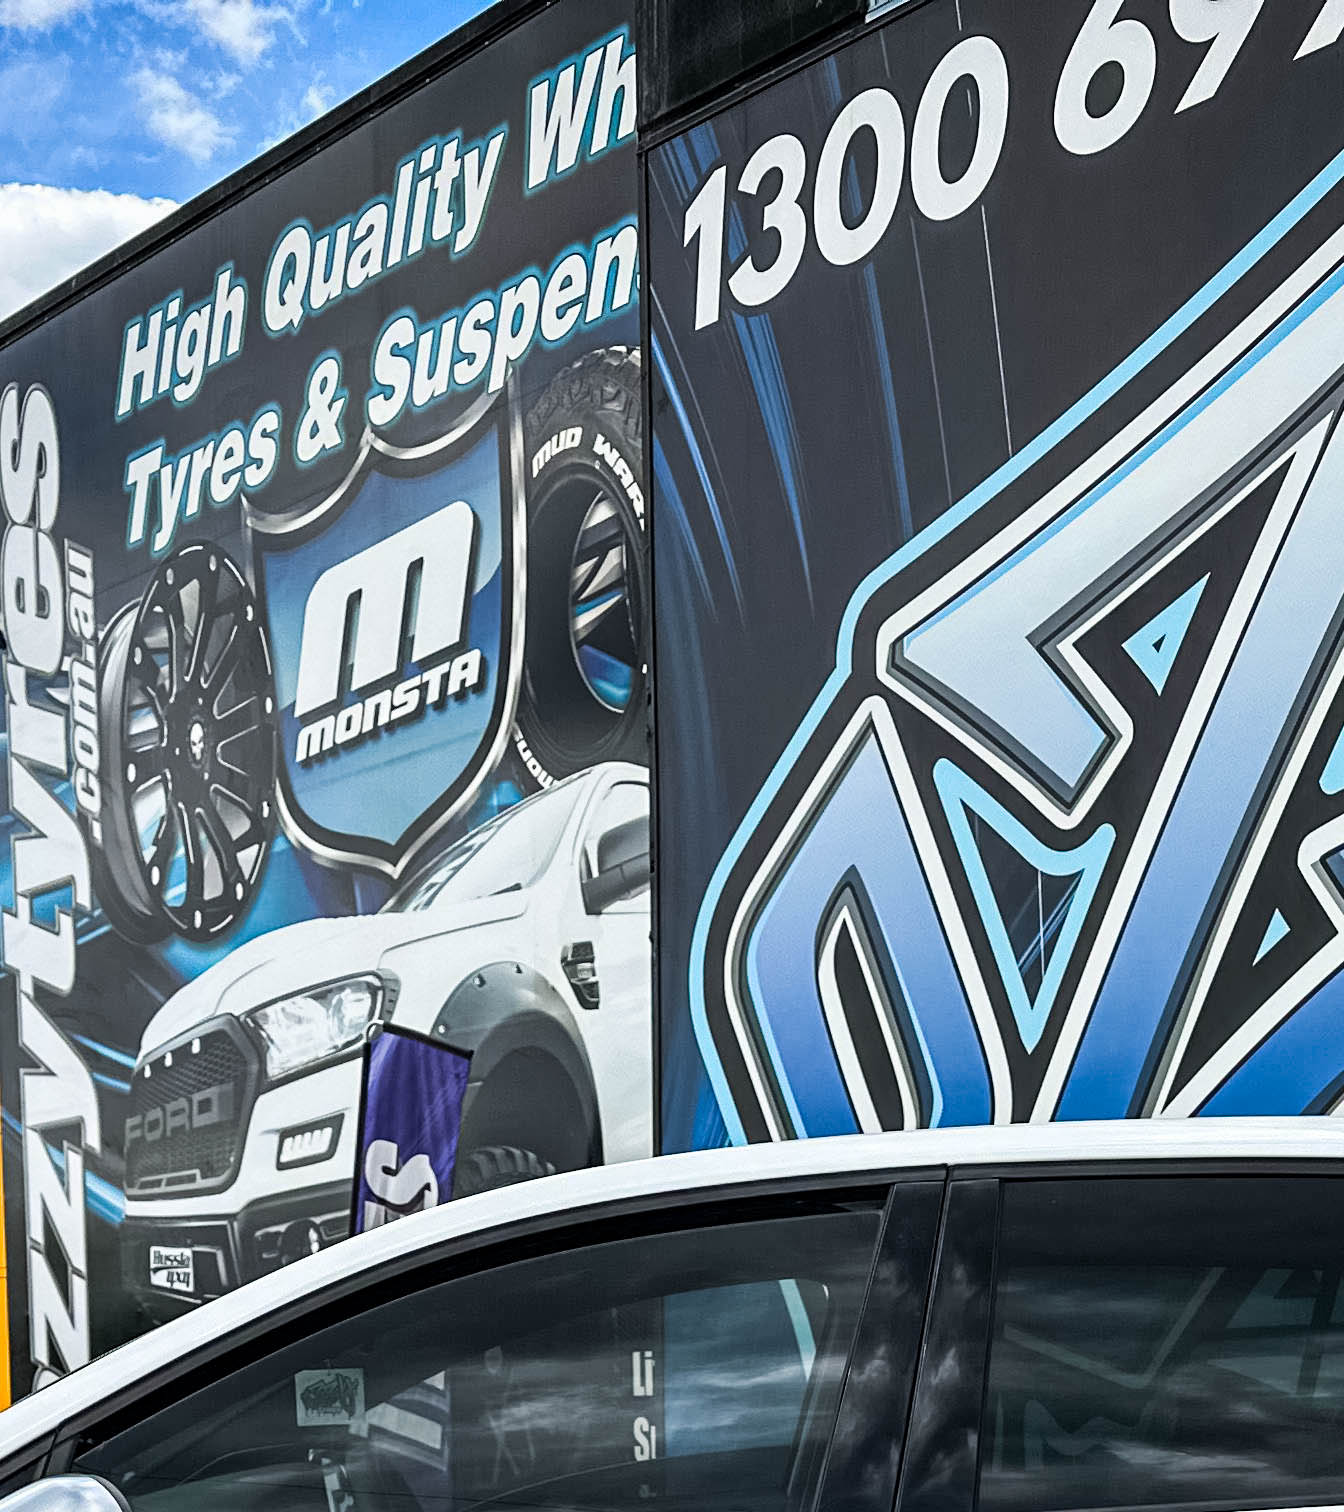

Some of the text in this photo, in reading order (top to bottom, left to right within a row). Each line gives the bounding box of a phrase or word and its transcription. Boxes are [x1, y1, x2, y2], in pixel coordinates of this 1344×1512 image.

[117, 34, 636, 416] High Quality Wh
[683, 35, 1010, 331] 1300
[127, 224, 640, 552] Tyres & Suspen
[593, 433, 645, 531] WAR
[0, 383, 102, 1396] zzytyres
[124, 1082, 234, 1147] FORD
